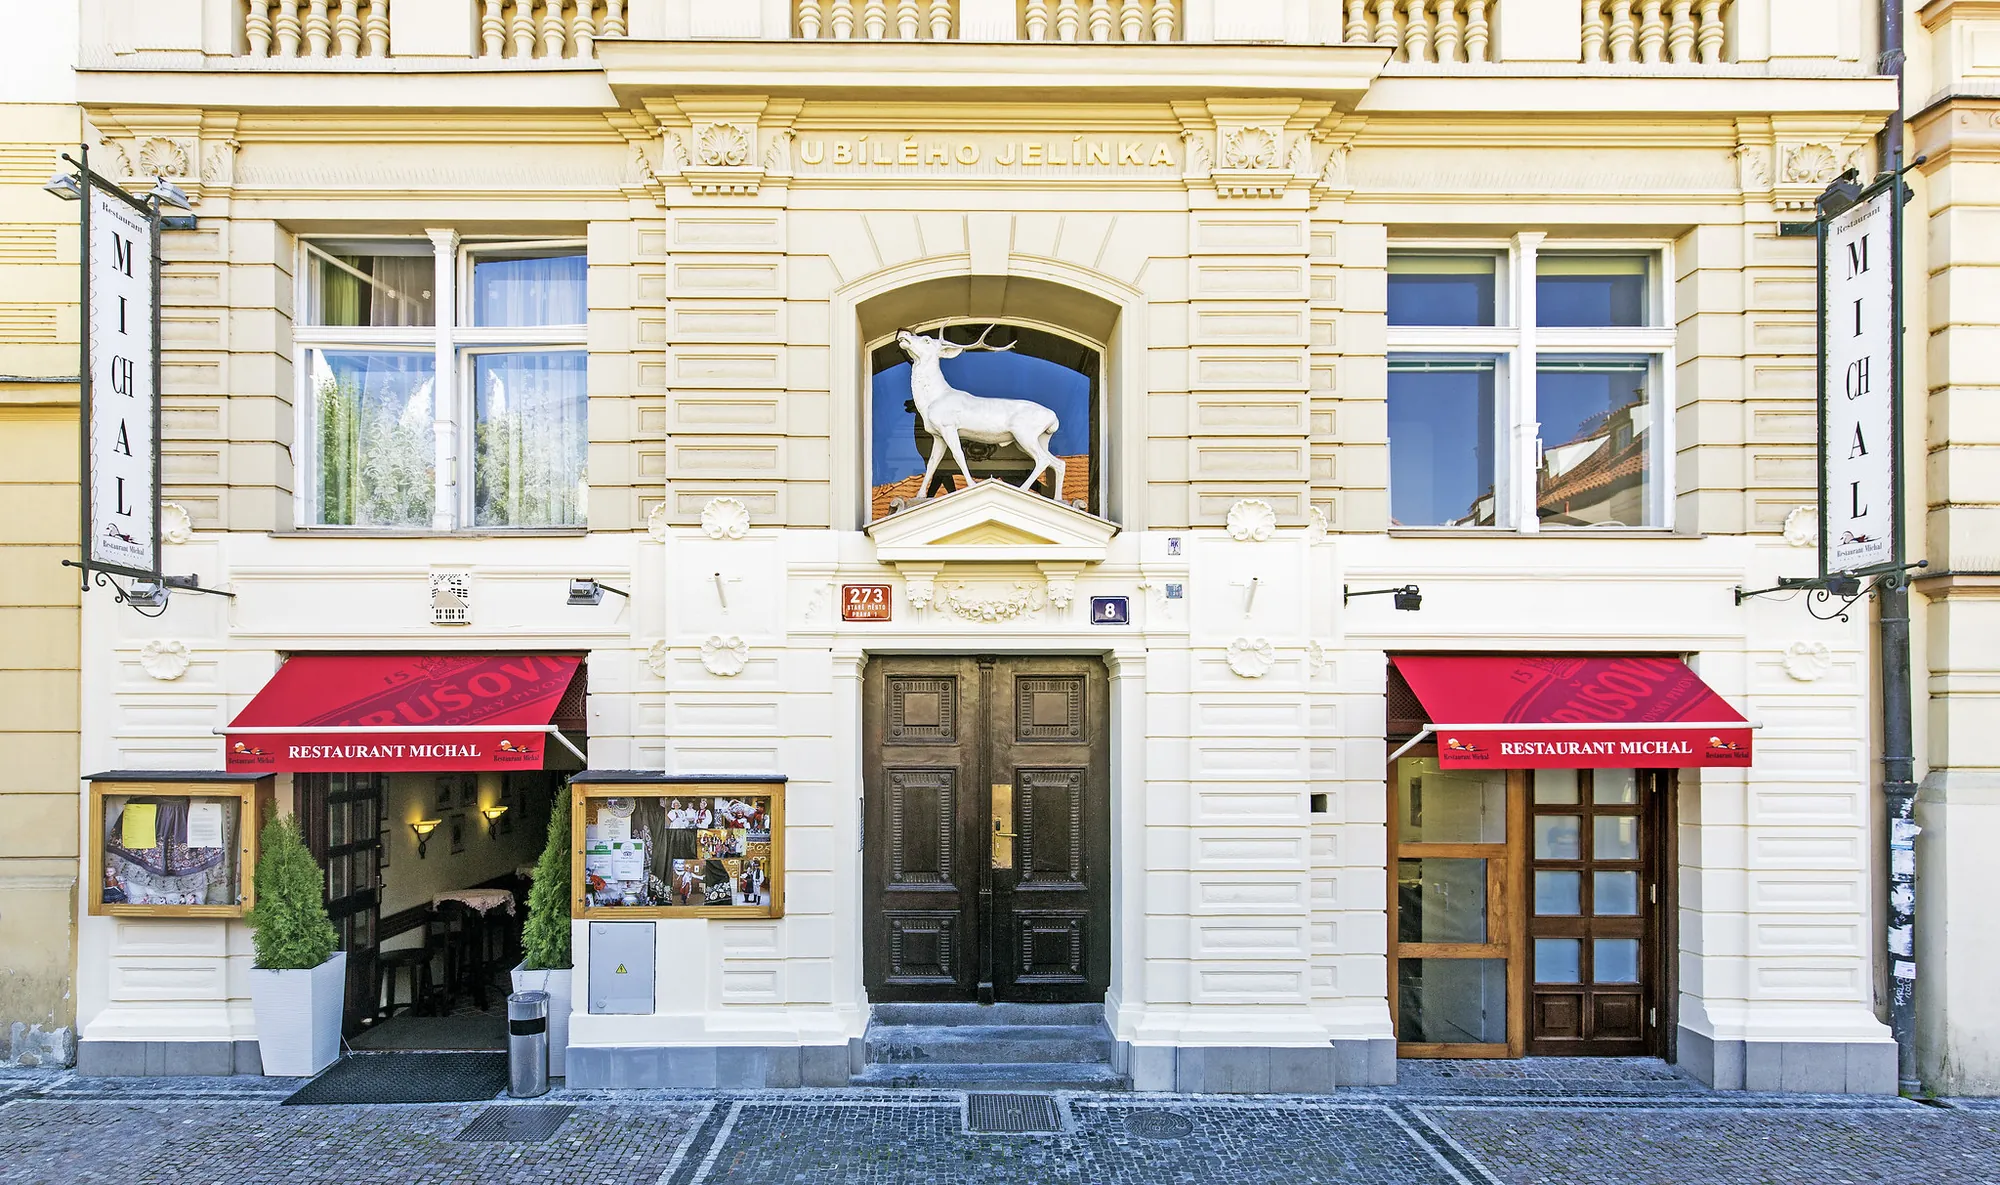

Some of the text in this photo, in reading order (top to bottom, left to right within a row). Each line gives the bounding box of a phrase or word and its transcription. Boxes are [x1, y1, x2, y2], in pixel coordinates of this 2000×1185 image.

[995, 135, 1175, 166] JELÍNKA
[102, 201, 143, 233] Restaurant
[1837, 206, 1880, 235] Restaurant
[102, 540, 128, 552] Restaurant
[130, 546, 145, 555] Michal
[1837, 548, 1863, 557] Restaurant
[1865, 542, 1883, 552] Michal
[850, 588, 883, 604] 273
[1105, 602, 1115, 618] 8
[288, 744, 482, 758] RESTAURANT MICHAL
[1501, 741, 1693, 755] RESTAURANT MICHAL
